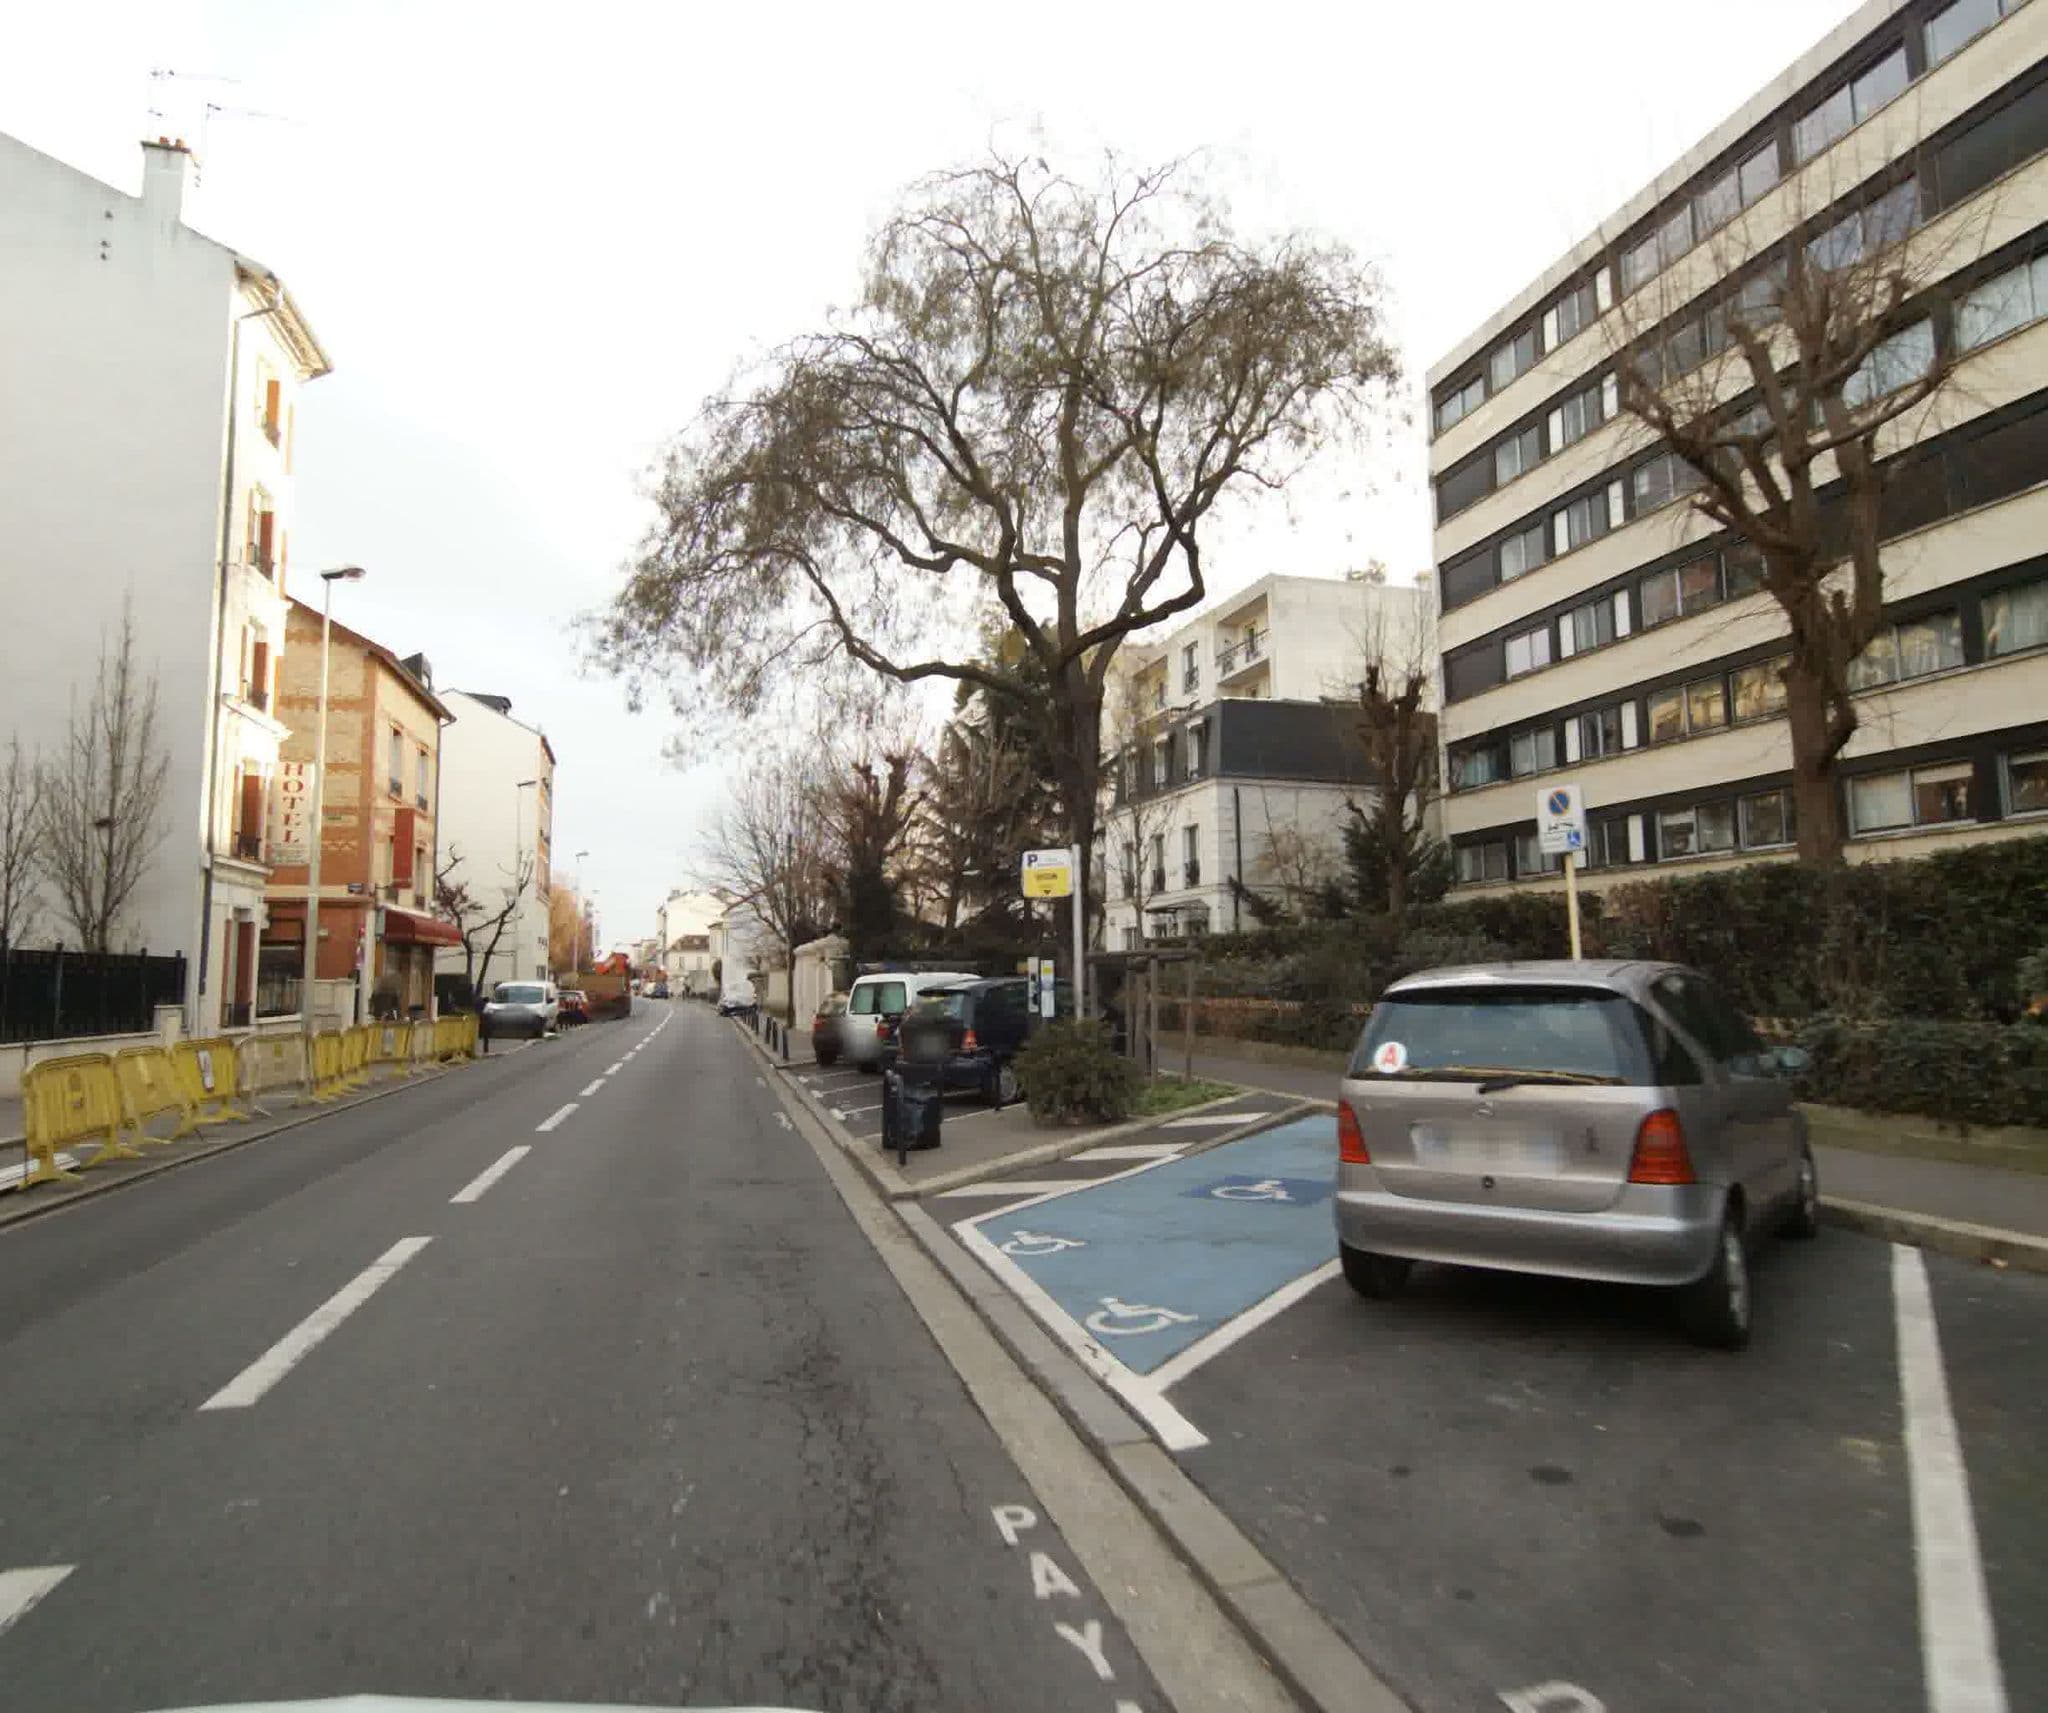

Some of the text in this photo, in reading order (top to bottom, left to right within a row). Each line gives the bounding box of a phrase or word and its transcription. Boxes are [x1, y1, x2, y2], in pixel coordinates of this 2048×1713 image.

[282, 762, 304, 843] HOTEL
[1027, 854, 1038, 867] P
[1382, 1044, 1398, 1065] A
[991, 1505, 1143, 1713] PAY
